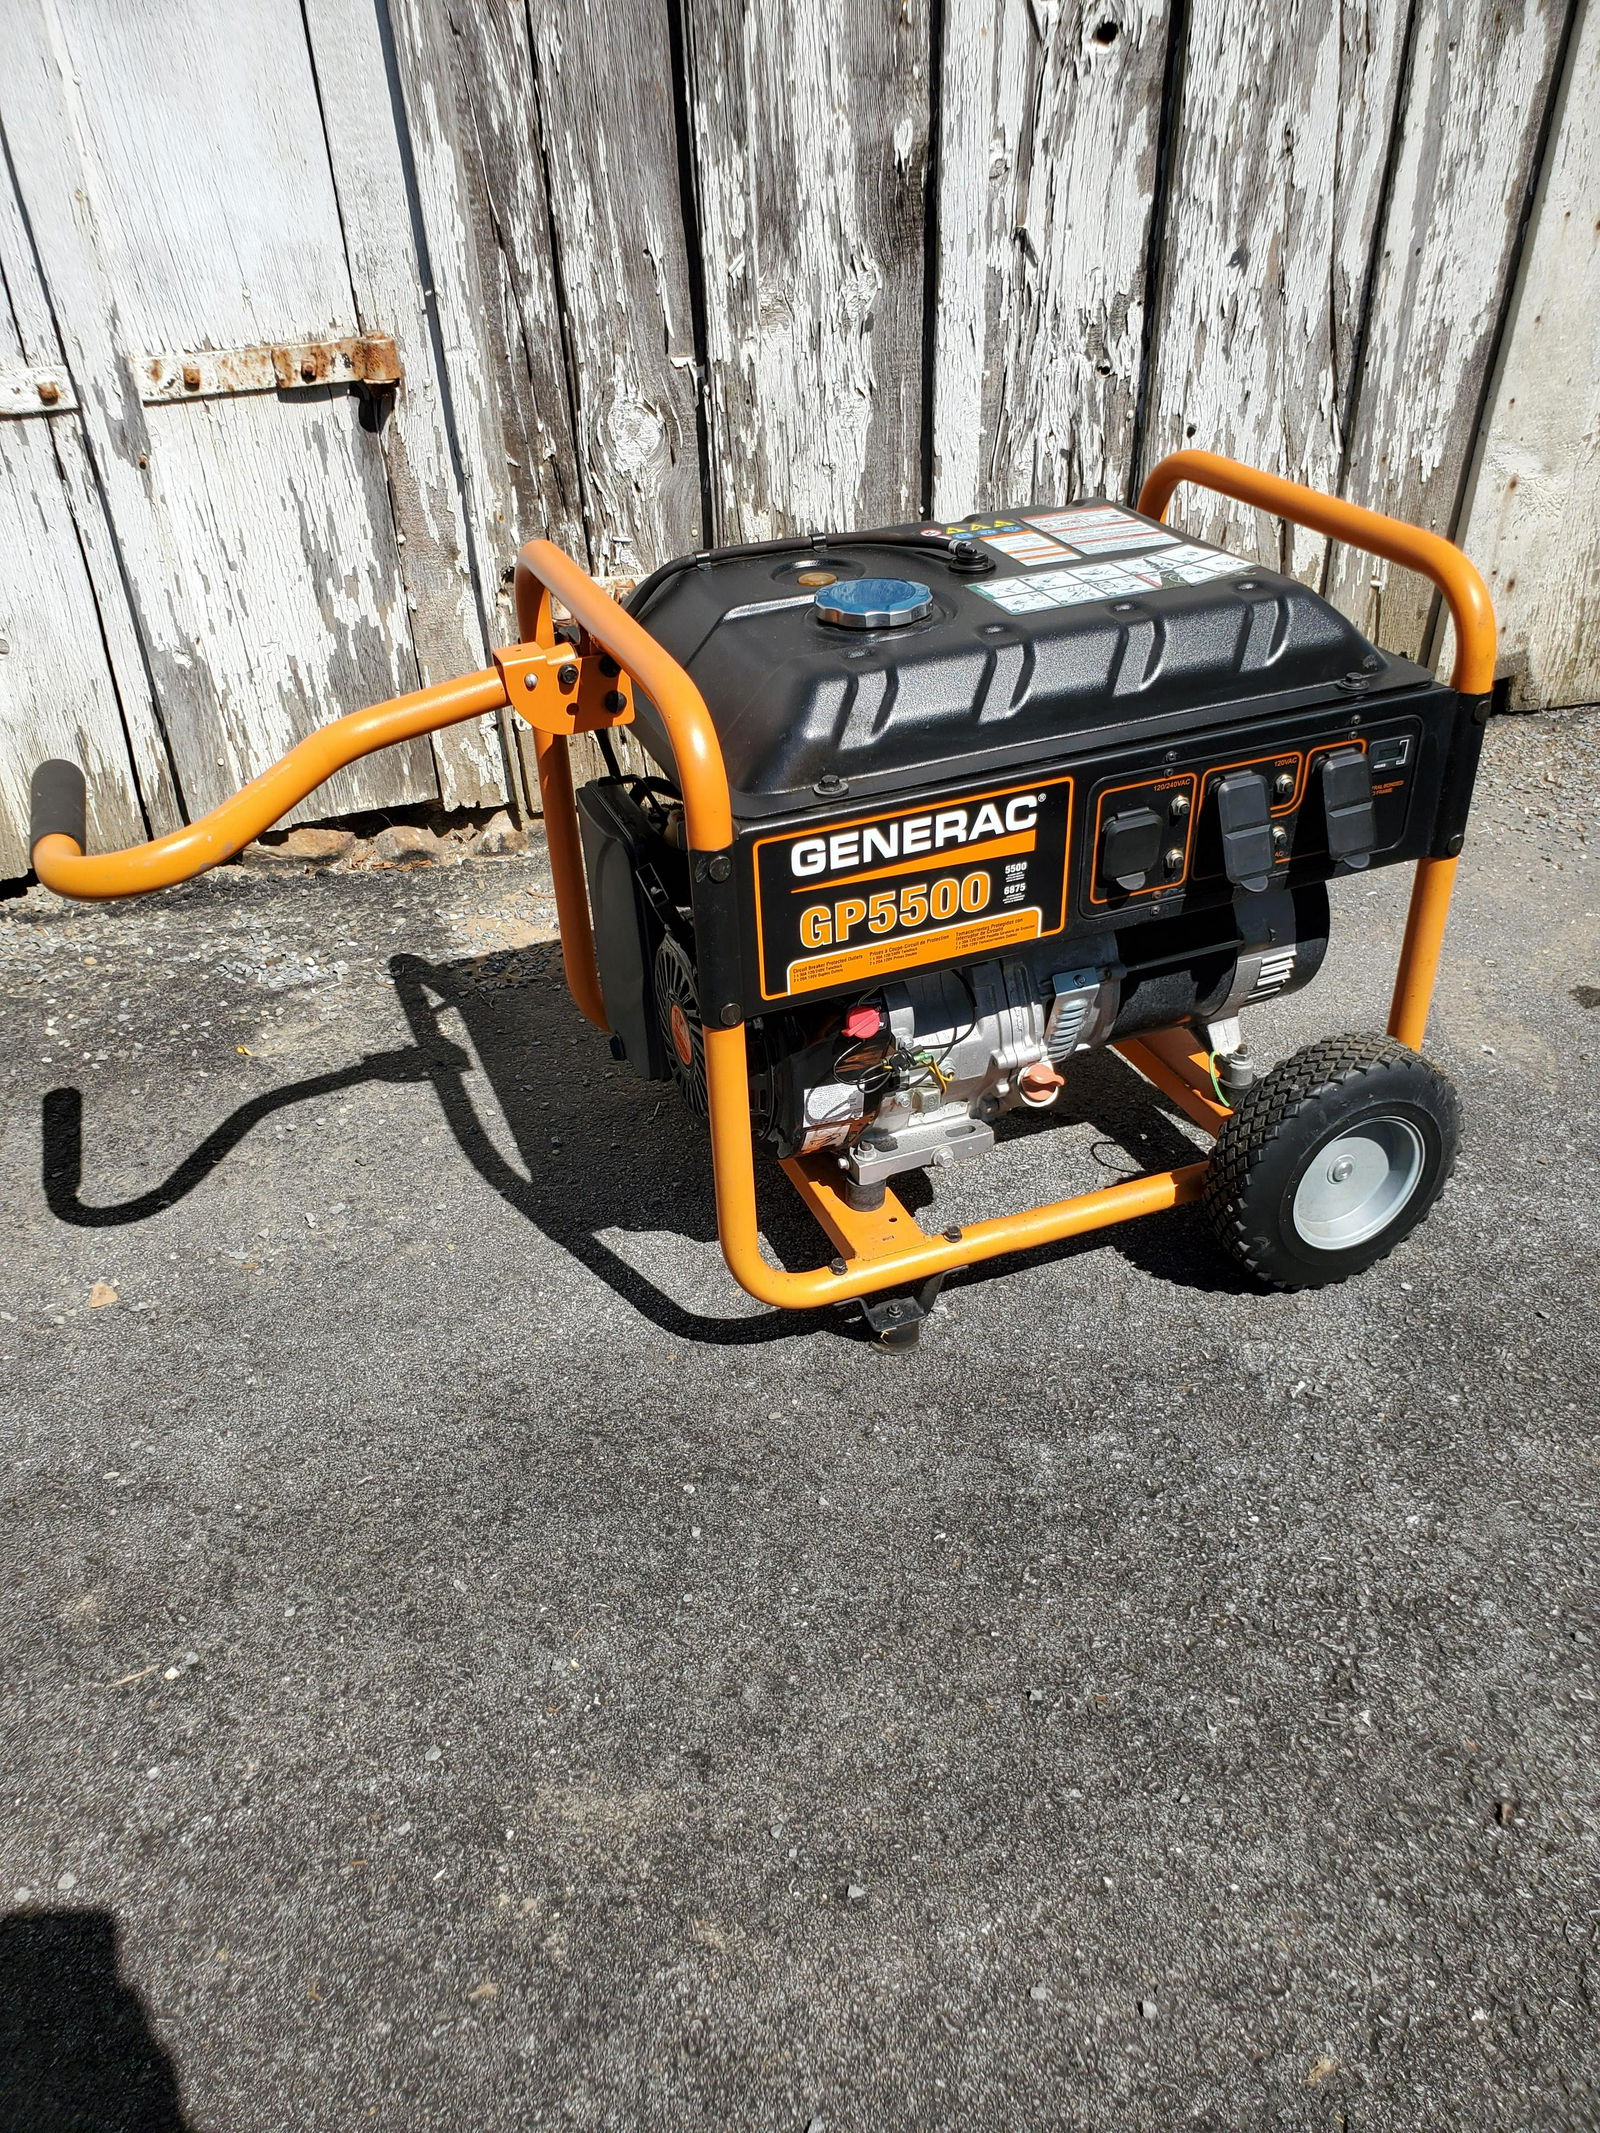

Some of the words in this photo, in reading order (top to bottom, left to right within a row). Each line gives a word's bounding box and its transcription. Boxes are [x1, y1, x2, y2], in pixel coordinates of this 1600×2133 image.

[1273, 756, 1298, 768] 120VAC
[1152, 777, 1191, 792] 120/240VAC
[1005, 861, 1027, 874] 5500
[1003, 882, 1026, 895] 6875
[800, 871, 991, 949] GP5500
